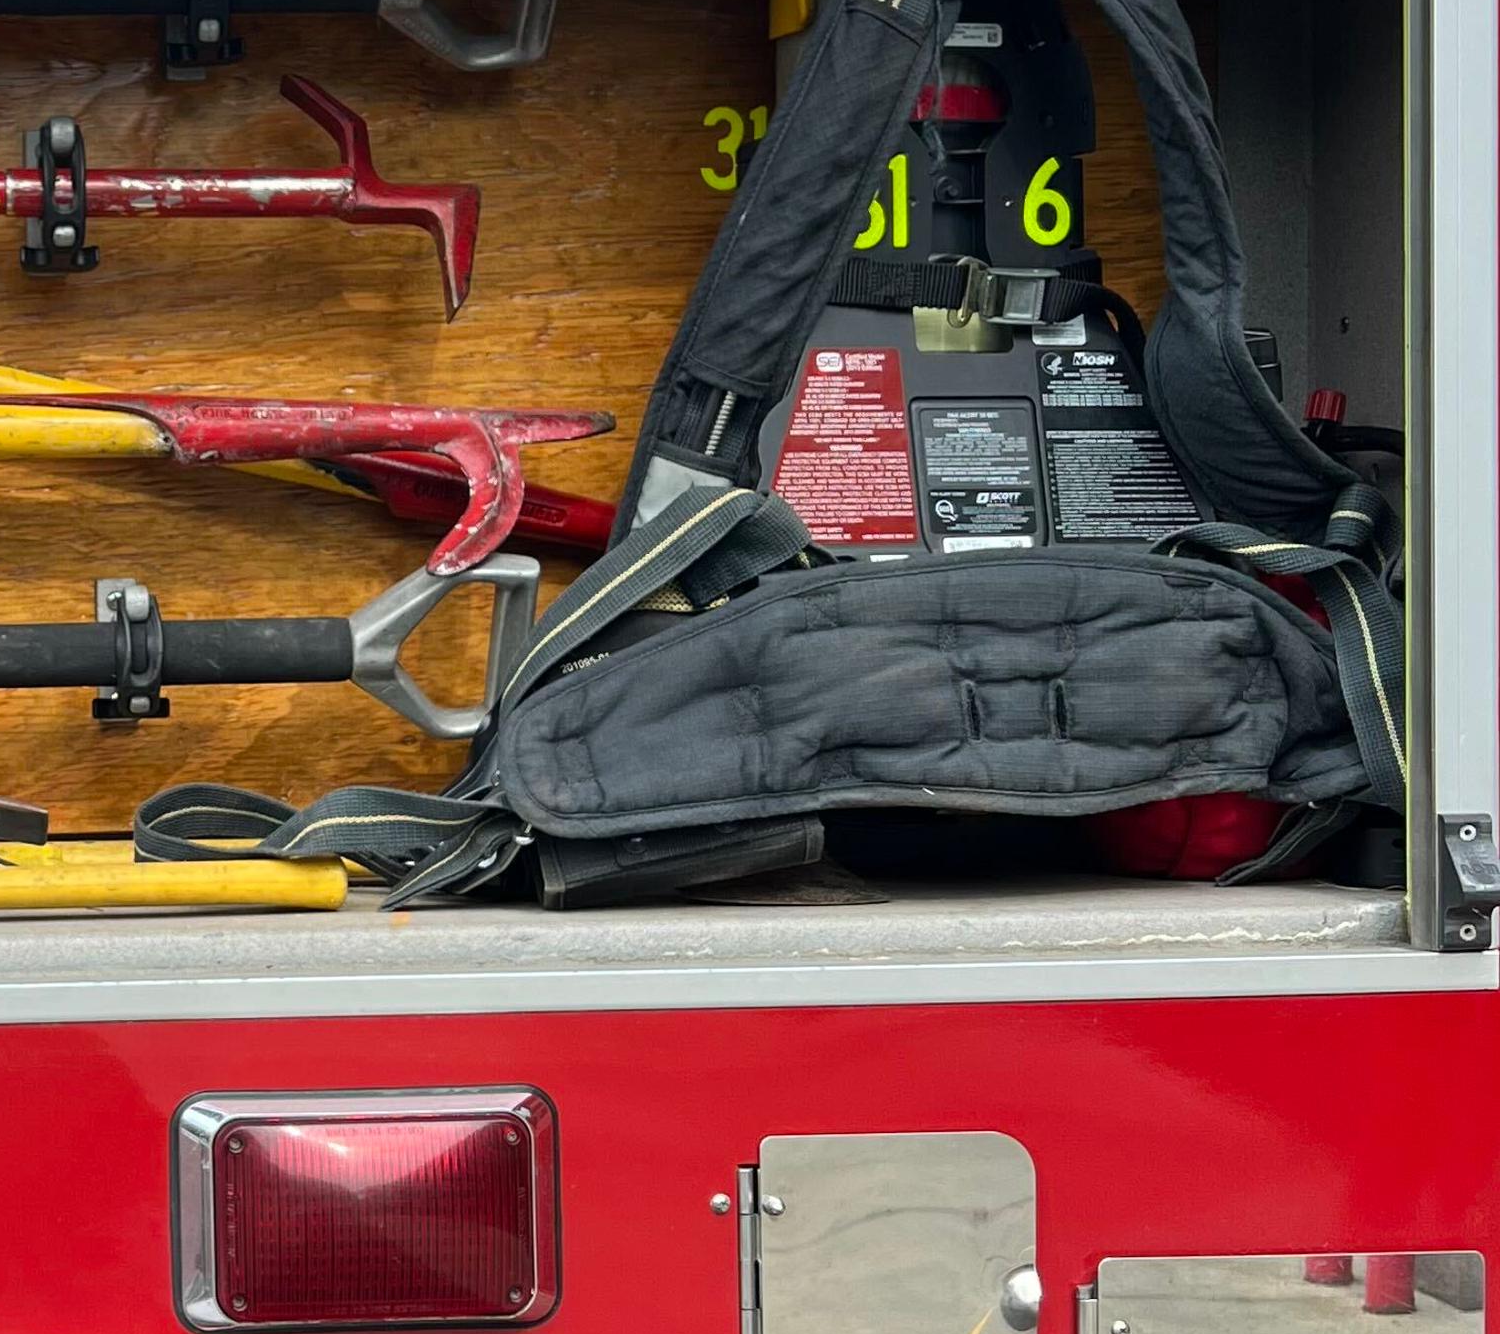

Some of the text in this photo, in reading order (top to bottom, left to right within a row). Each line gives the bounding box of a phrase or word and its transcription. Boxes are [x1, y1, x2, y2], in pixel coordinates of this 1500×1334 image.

[1023, 156, 1071, 246] 6
[1073, 354, 1116, 365] NIOSH
[990, 492, 1021, 500] SCOTT
